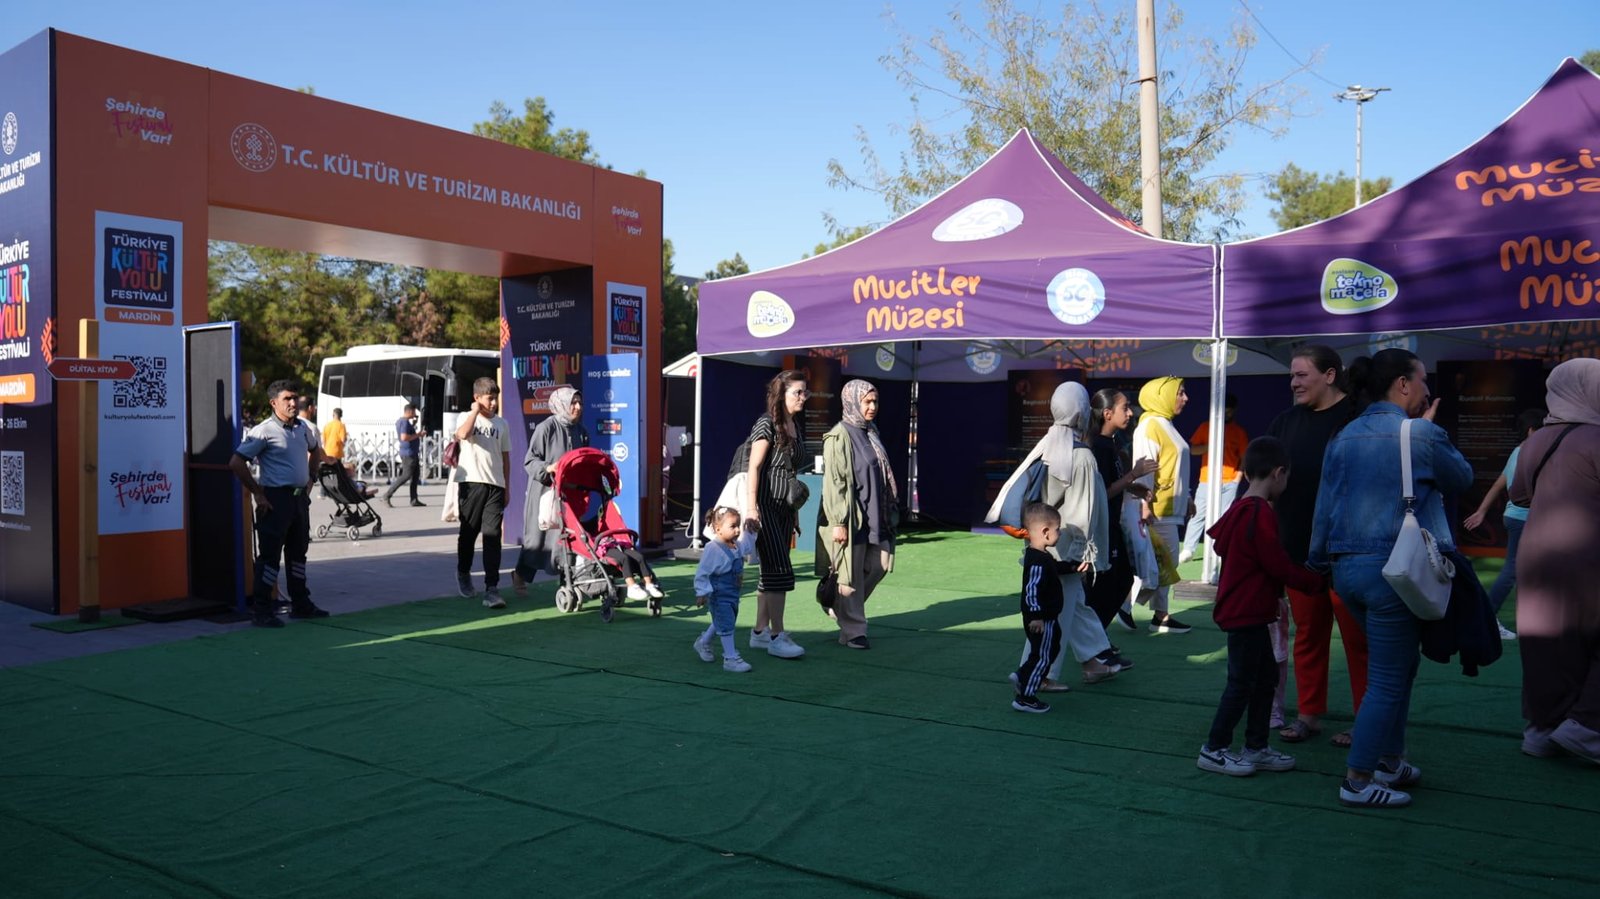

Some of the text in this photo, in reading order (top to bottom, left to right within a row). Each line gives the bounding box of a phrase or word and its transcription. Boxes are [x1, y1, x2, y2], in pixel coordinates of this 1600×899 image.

[105, 97, 166, 120] Şehirde
[141, 129, 173, 145] Var!
[1455, 149, 1600, 190] Muci
[281, 144, 581, 220] T.C. KÜLTÜR VE TURİZM BAKANLIĞI
[111, 233, 168, 251] TÜRKİYE
[111, 247, 168, 274] KÜLTÜR
[120, 268, 162, 291] YOLU
[853, 267, 981, 304] Mucitler
[1336, 271, 1384, 288] tekno
[111, 289, 168, 303] FESTİVALİ
[1329, 285, 1389, 301] macera
[526, 302, 547, 312] KÜLTÜR
[547, 301, 555, 310] VE
[614, 297, 640, 307] TÜRKİYE
[119, 311, 161, 322] MARDİN
[866, 301, 964, 333] Müzesi
[530, 339, 561, 352] TÜRKİYE
[512, 354, 550, 379] KÜLTÜR
[14, 417, 27, 429] Ekim
[109, 470, 164, 485] Şehirde
[142, 493, 171, 505] Var!
